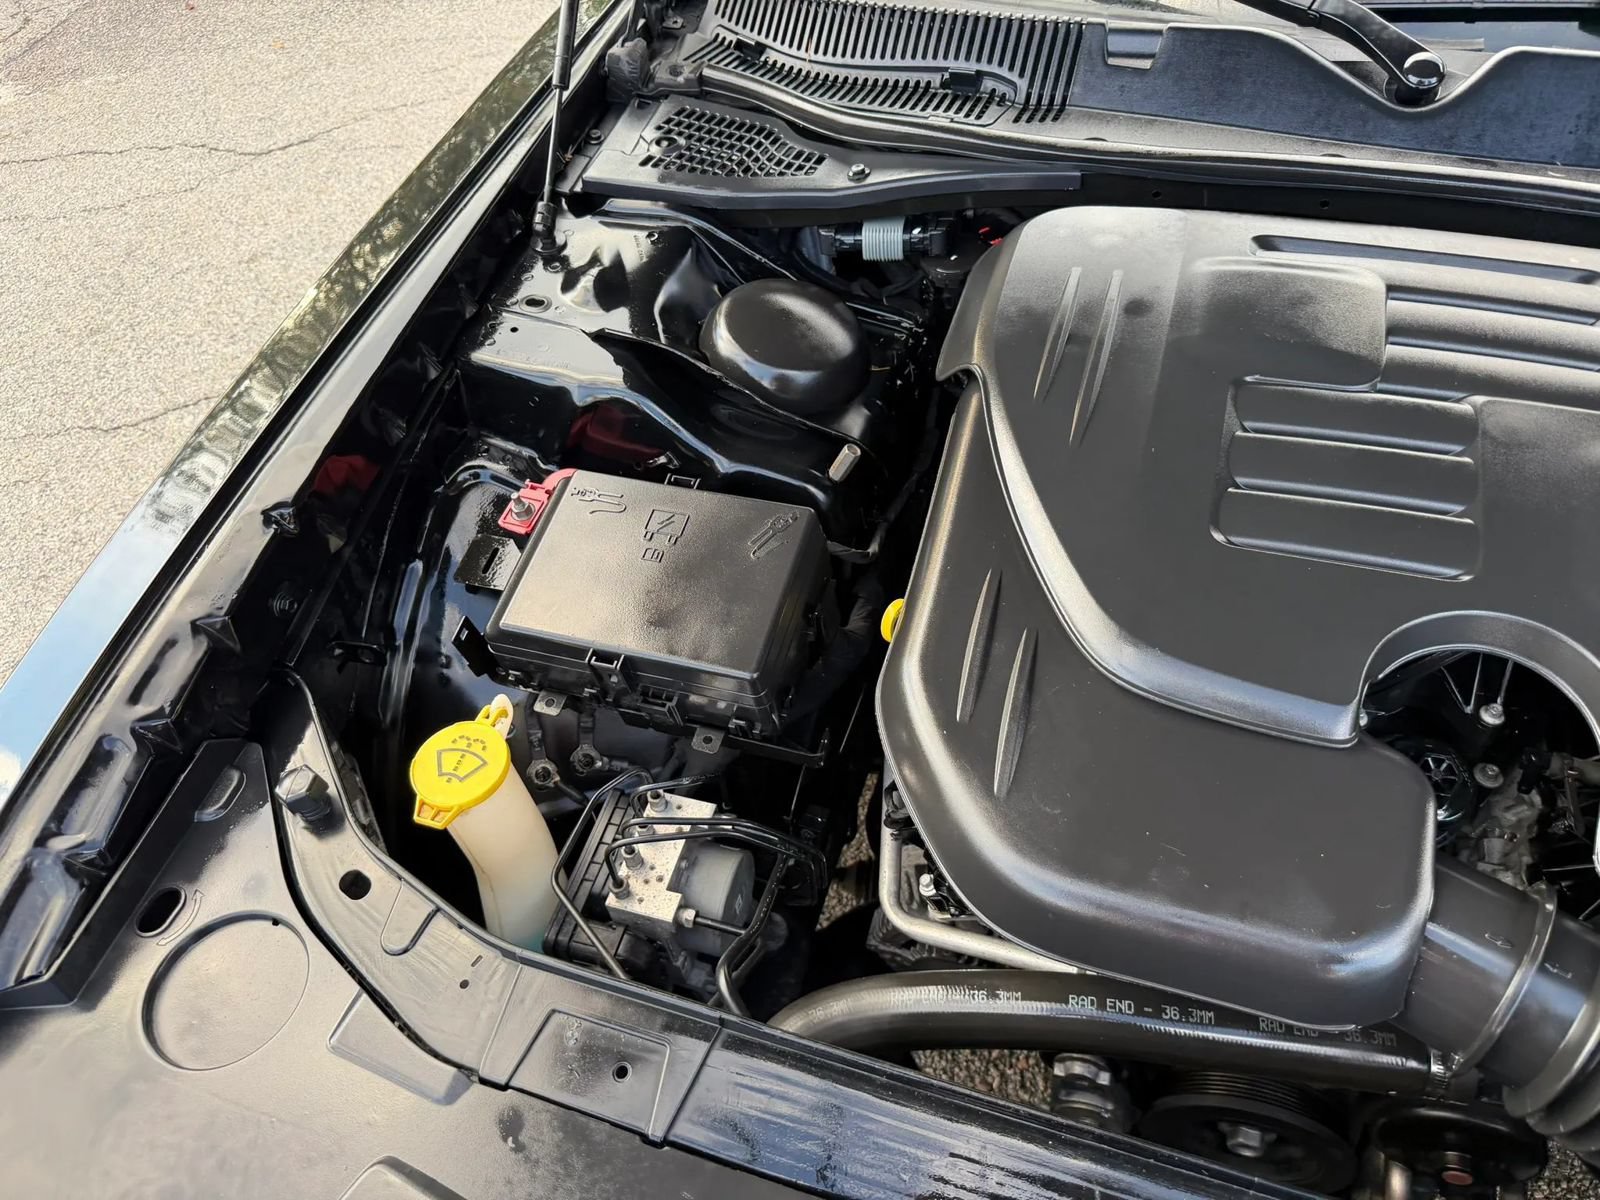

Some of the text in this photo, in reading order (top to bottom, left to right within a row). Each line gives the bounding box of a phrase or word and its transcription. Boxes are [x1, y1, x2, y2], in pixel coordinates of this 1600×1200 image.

[1068, 994, 1097, 1010] RAD
[1106, 998, 1135, 1014] END
[1161, 1004, 1215, 1024] 36.3MM
[1258, 1016, 1286, 1033] RAD
